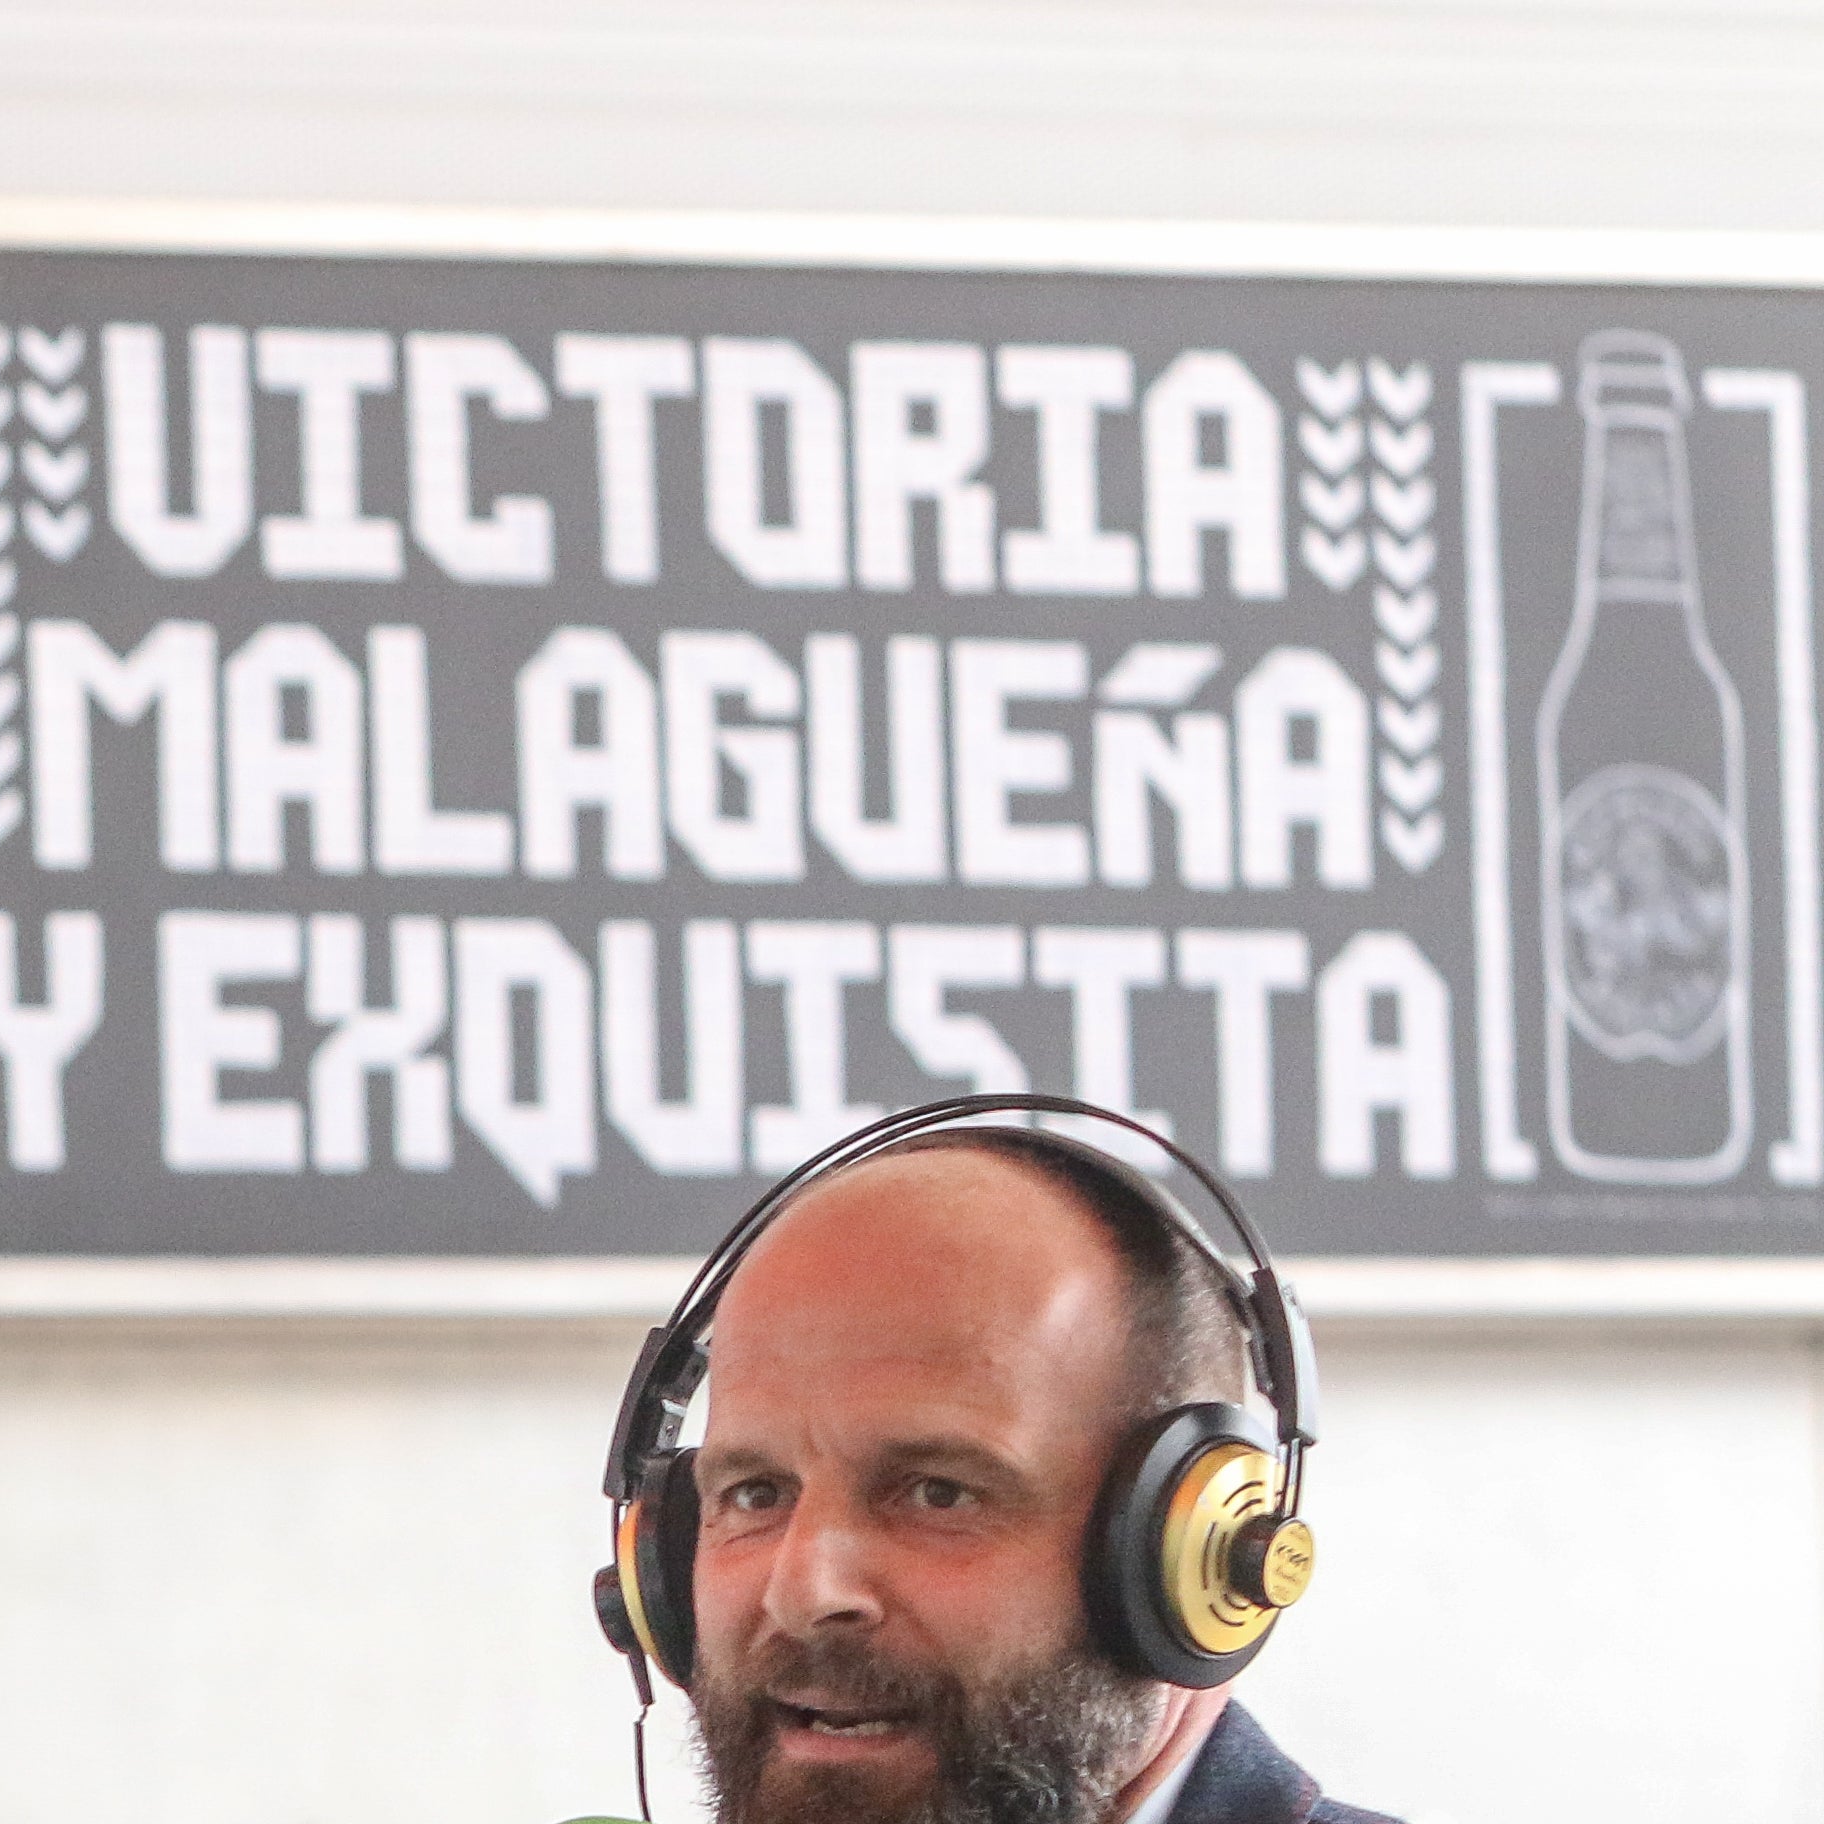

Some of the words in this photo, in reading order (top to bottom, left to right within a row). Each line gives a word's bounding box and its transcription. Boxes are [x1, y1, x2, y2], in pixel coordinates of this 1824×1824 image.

[102, 324, 1284, 600] VICTORIA
[28, 620, 1372, 890] MALAGUEÑA
[158, 911, 1457, 1208] EXQUISITA
